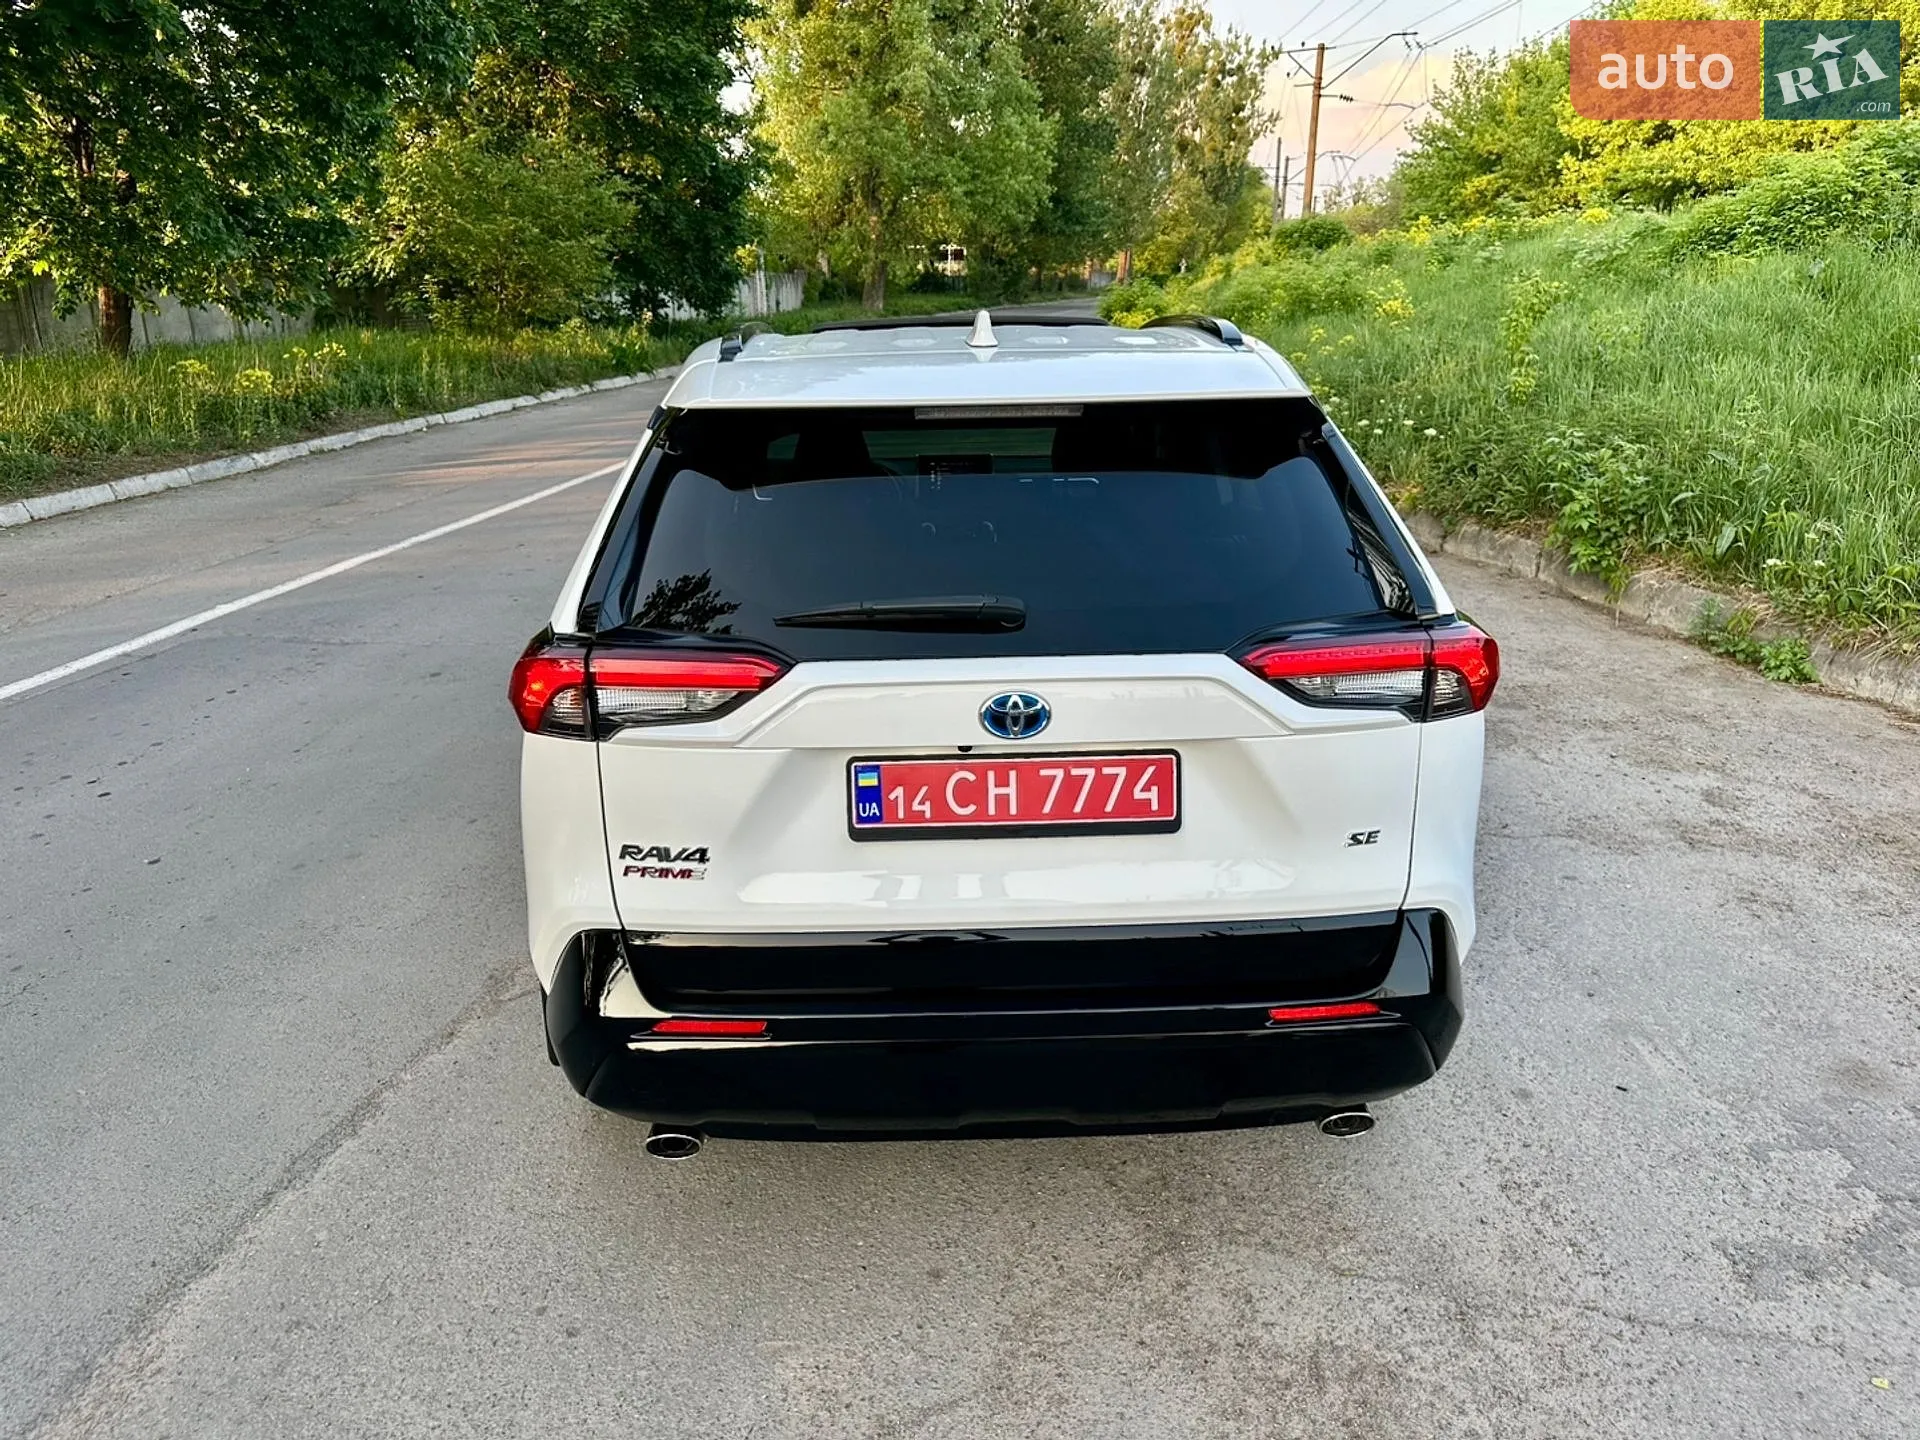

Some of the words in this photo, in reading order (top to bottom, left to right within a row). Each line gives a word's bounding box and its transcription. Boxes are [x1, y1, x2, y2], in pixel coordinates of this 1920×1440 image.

[888, 785, 931, 819] 14
[945, 769, 1018, 816] CH
[1039, 765, 1160, 814] 7774
[858, 802, 880, 817] UA
[1345, 829, 1381, 847] SE
[619, 844, 710, 864] RAV4
[623, 865, 707, 880] PRIME
